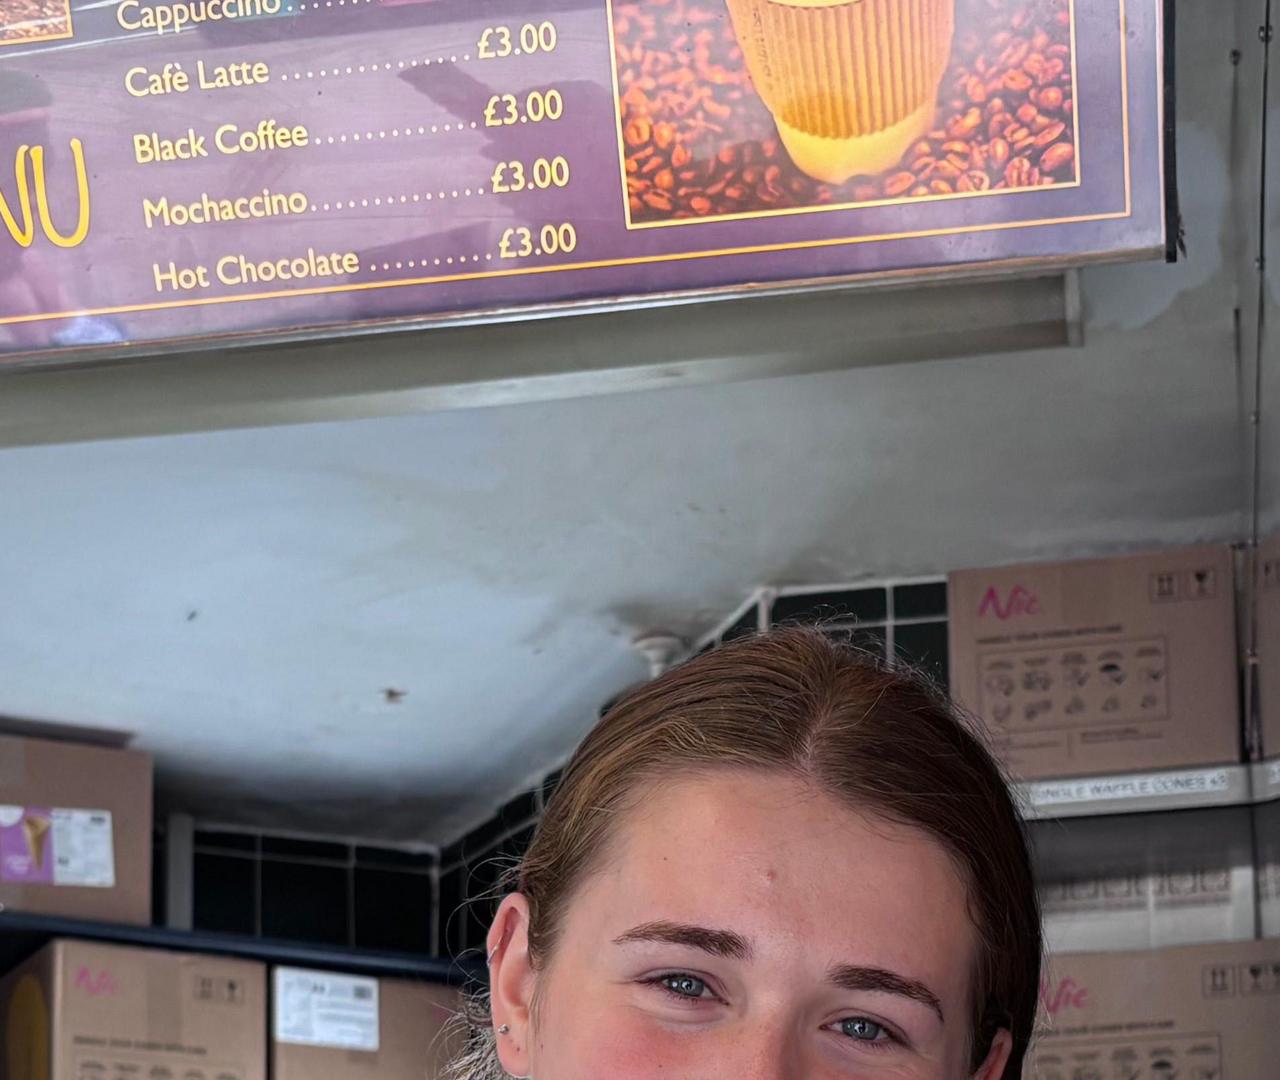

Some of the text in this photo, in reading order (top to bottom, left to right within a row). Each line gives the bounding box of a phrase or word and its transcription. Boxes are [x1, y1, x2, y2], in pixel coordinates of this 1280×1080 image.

[116, 0, 281, 35] Cappuccino
[477, 20, 558, 60] £3.00
[125, 60, 270, 97] Cafè Latte
[483, 90, 563, 128] £3.00
[133, 120, 309, 164] Black Coffee
[491, 156, 570, 194] £3.00
[143, 189, 308, 229] Mochaccino
[499, 223, 577, 259] £3.00
[153, 248, 359, 292] Hot Chocolate
